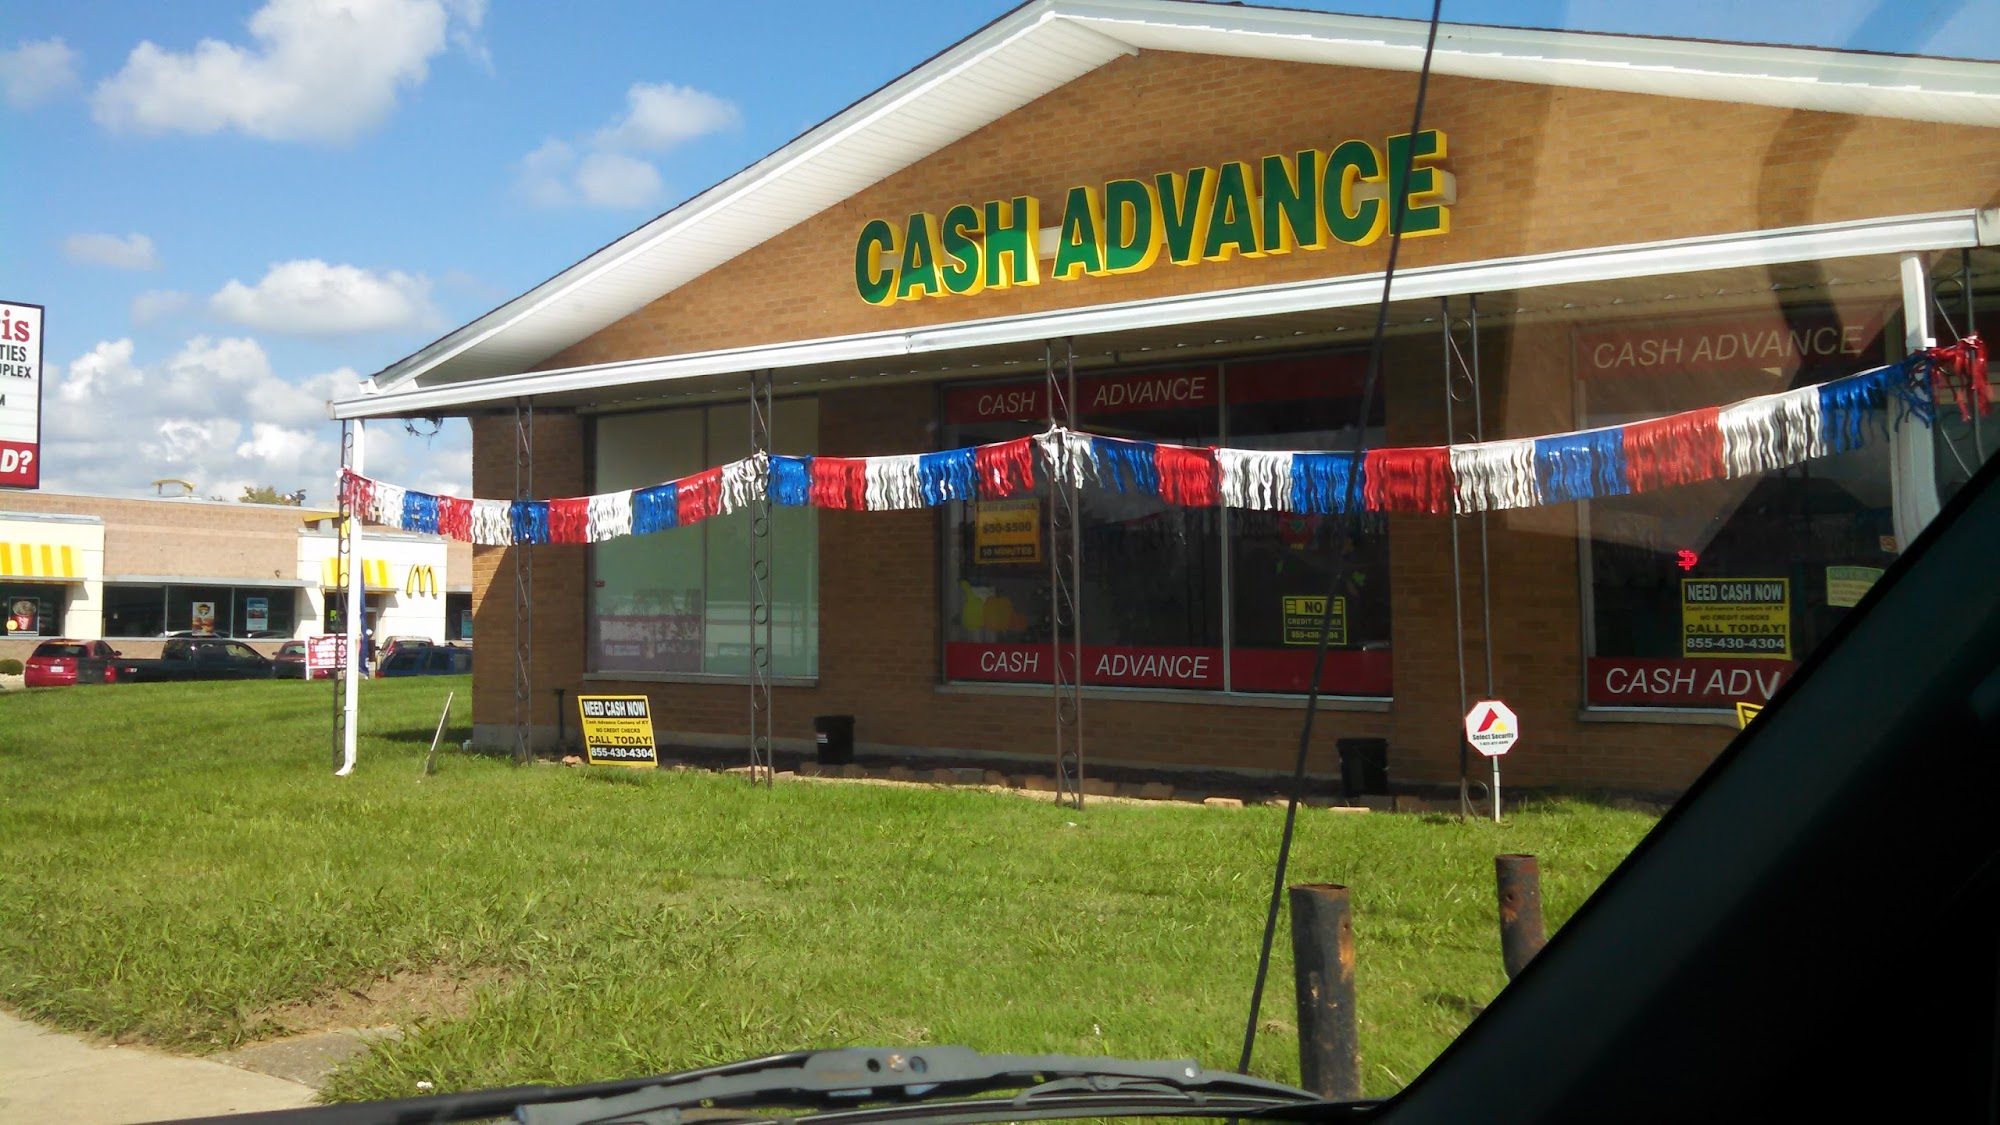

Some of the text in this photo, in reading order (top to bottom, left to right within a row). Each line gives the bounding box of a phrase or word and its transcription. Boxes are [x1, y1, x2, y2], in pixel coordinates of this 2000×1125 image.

[855, 129, 1450, 306] CASH ADVANCE
[1593, 325, 1865, 369] CASH ADVANCE
[0, 363, 32, 379] PLEX
[978, 377, 1207, 416] CASH ADVANCE
[1687, 584, 1782, 601] NEED CASH NOW
[1304, 601, 1323, 613] NO
[1685, 624, 1786, 633] CALL TODAY!
[1687, 638, 1785, 649] 855-430-4304
[980, 651, 1210, 679] CASH ADVANCE
[1605, 667, 1697, 694] CASH
[583, 701, 646, 716] NEED CASH NOW
[588, 735, 653, 745] CALL TODAY!
[1491, 732, 1514, 740] Security
[591, 747, 654, 758] 855-430-4304
